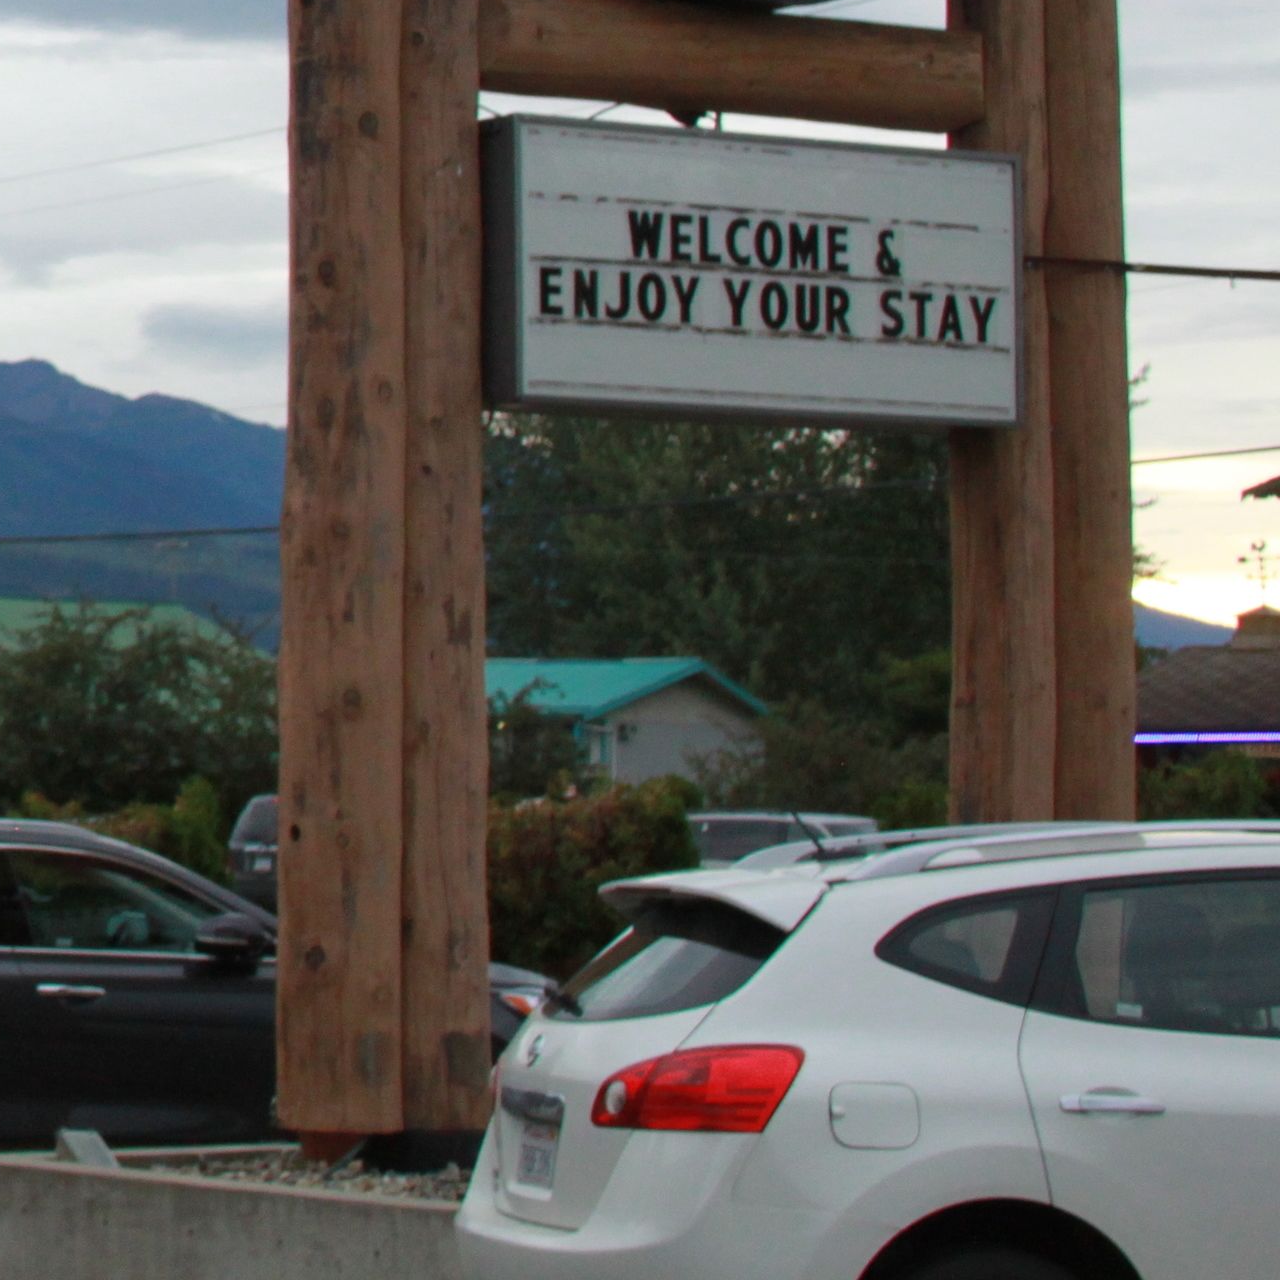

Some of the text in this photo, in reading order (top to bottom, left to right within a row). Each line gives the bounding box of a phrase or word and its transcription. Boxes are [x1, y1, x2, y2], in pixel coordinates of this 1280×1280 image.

[628, 210, 902, 277] WELCOME &
[539, 266, 997, 343] ENJOY YOUR STAY
